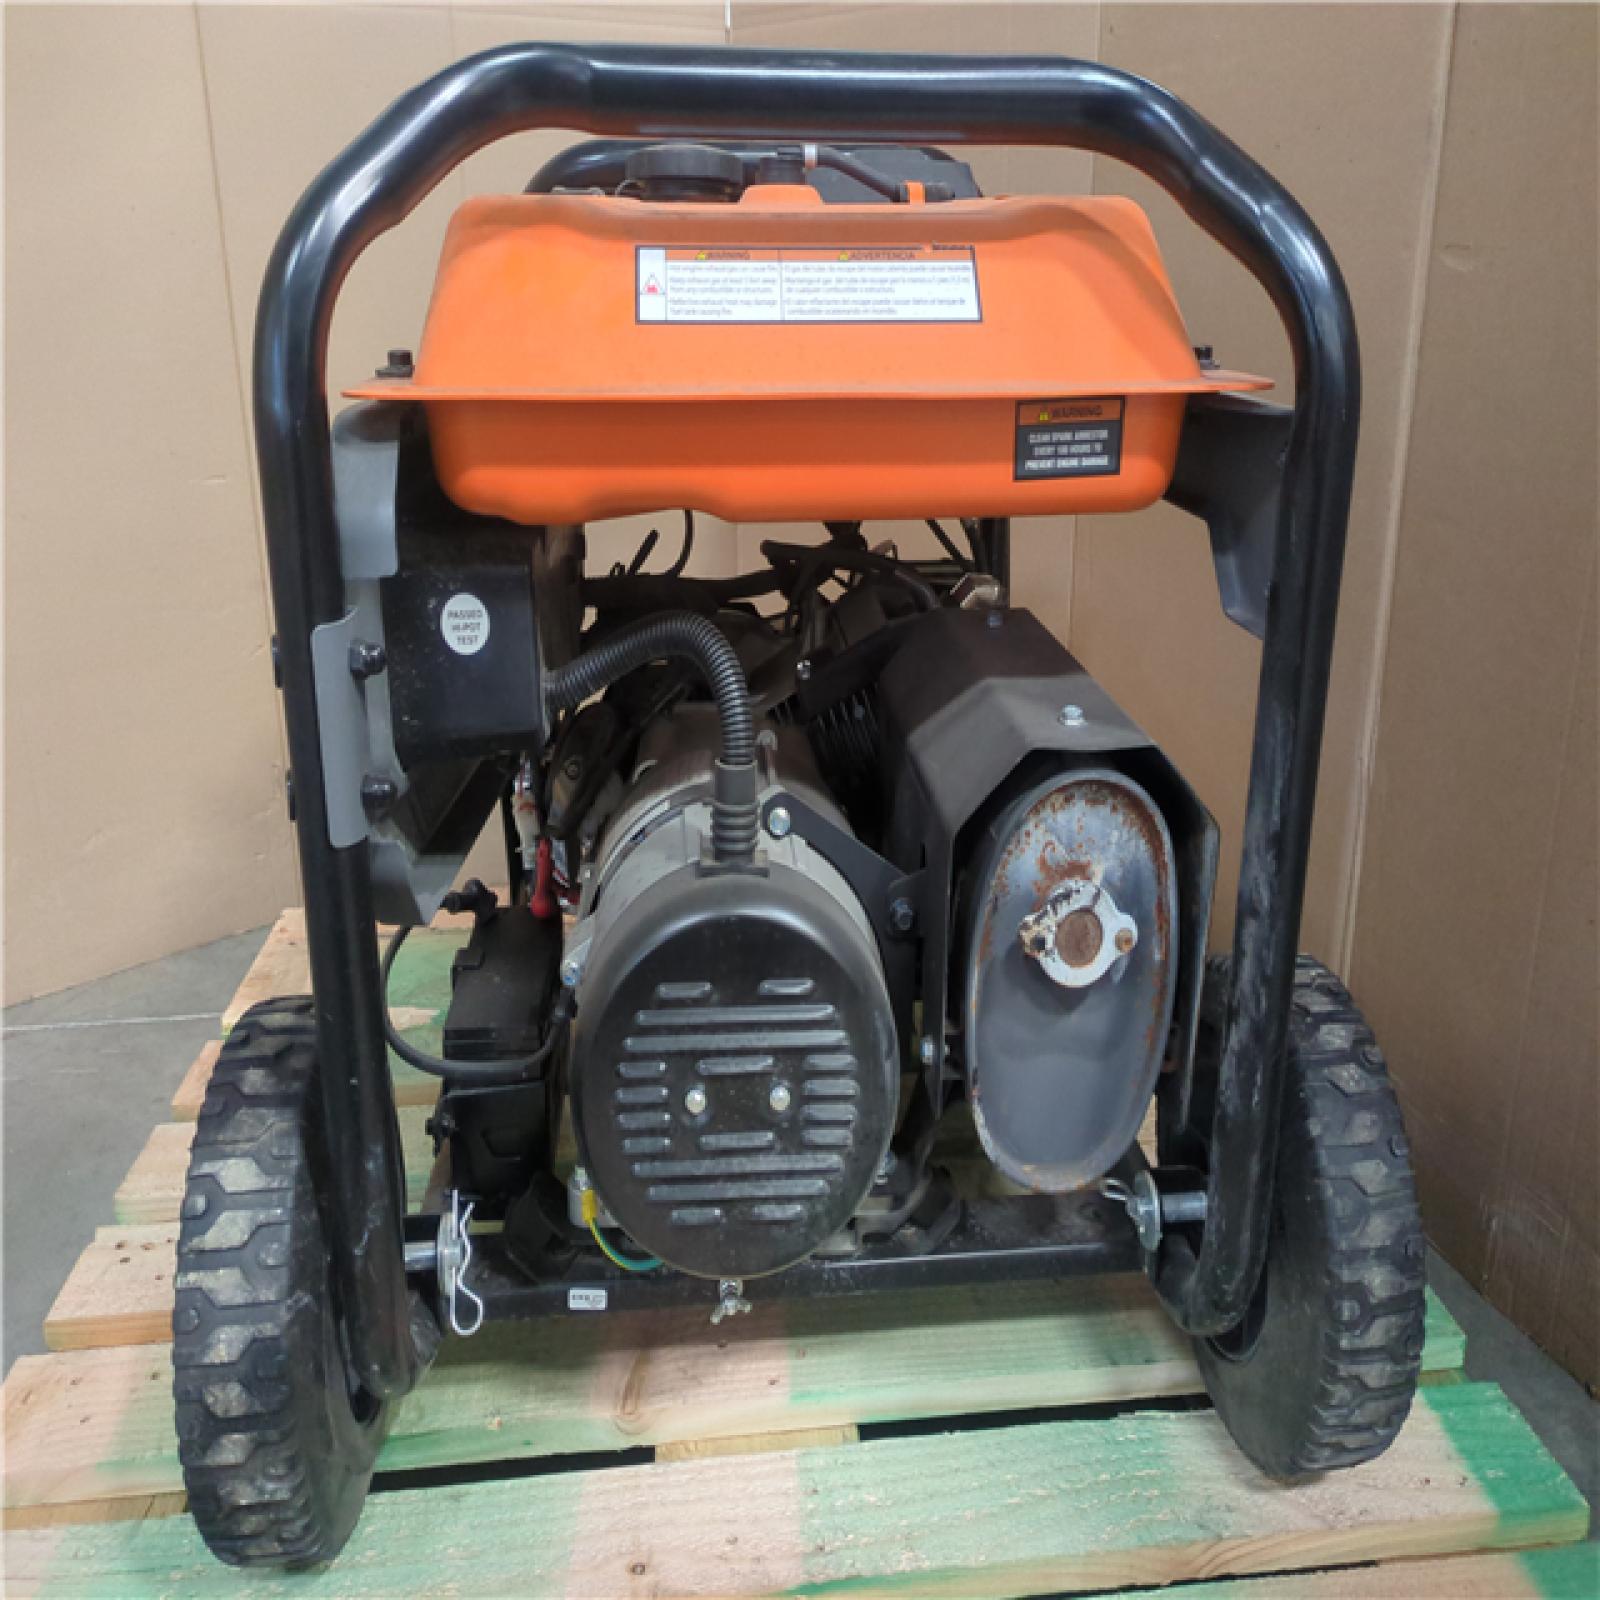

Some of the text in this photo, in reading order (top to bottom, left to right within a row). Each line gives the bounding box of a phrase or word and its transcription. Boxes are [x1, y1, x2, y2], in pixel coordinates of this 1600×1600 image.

[706, 251, 750, 260] WARNING
[1051, 405, 1104, 417] WARNING
[447, 609, 483, 618] PASSED
[457, 635, 479, 645] TEST
